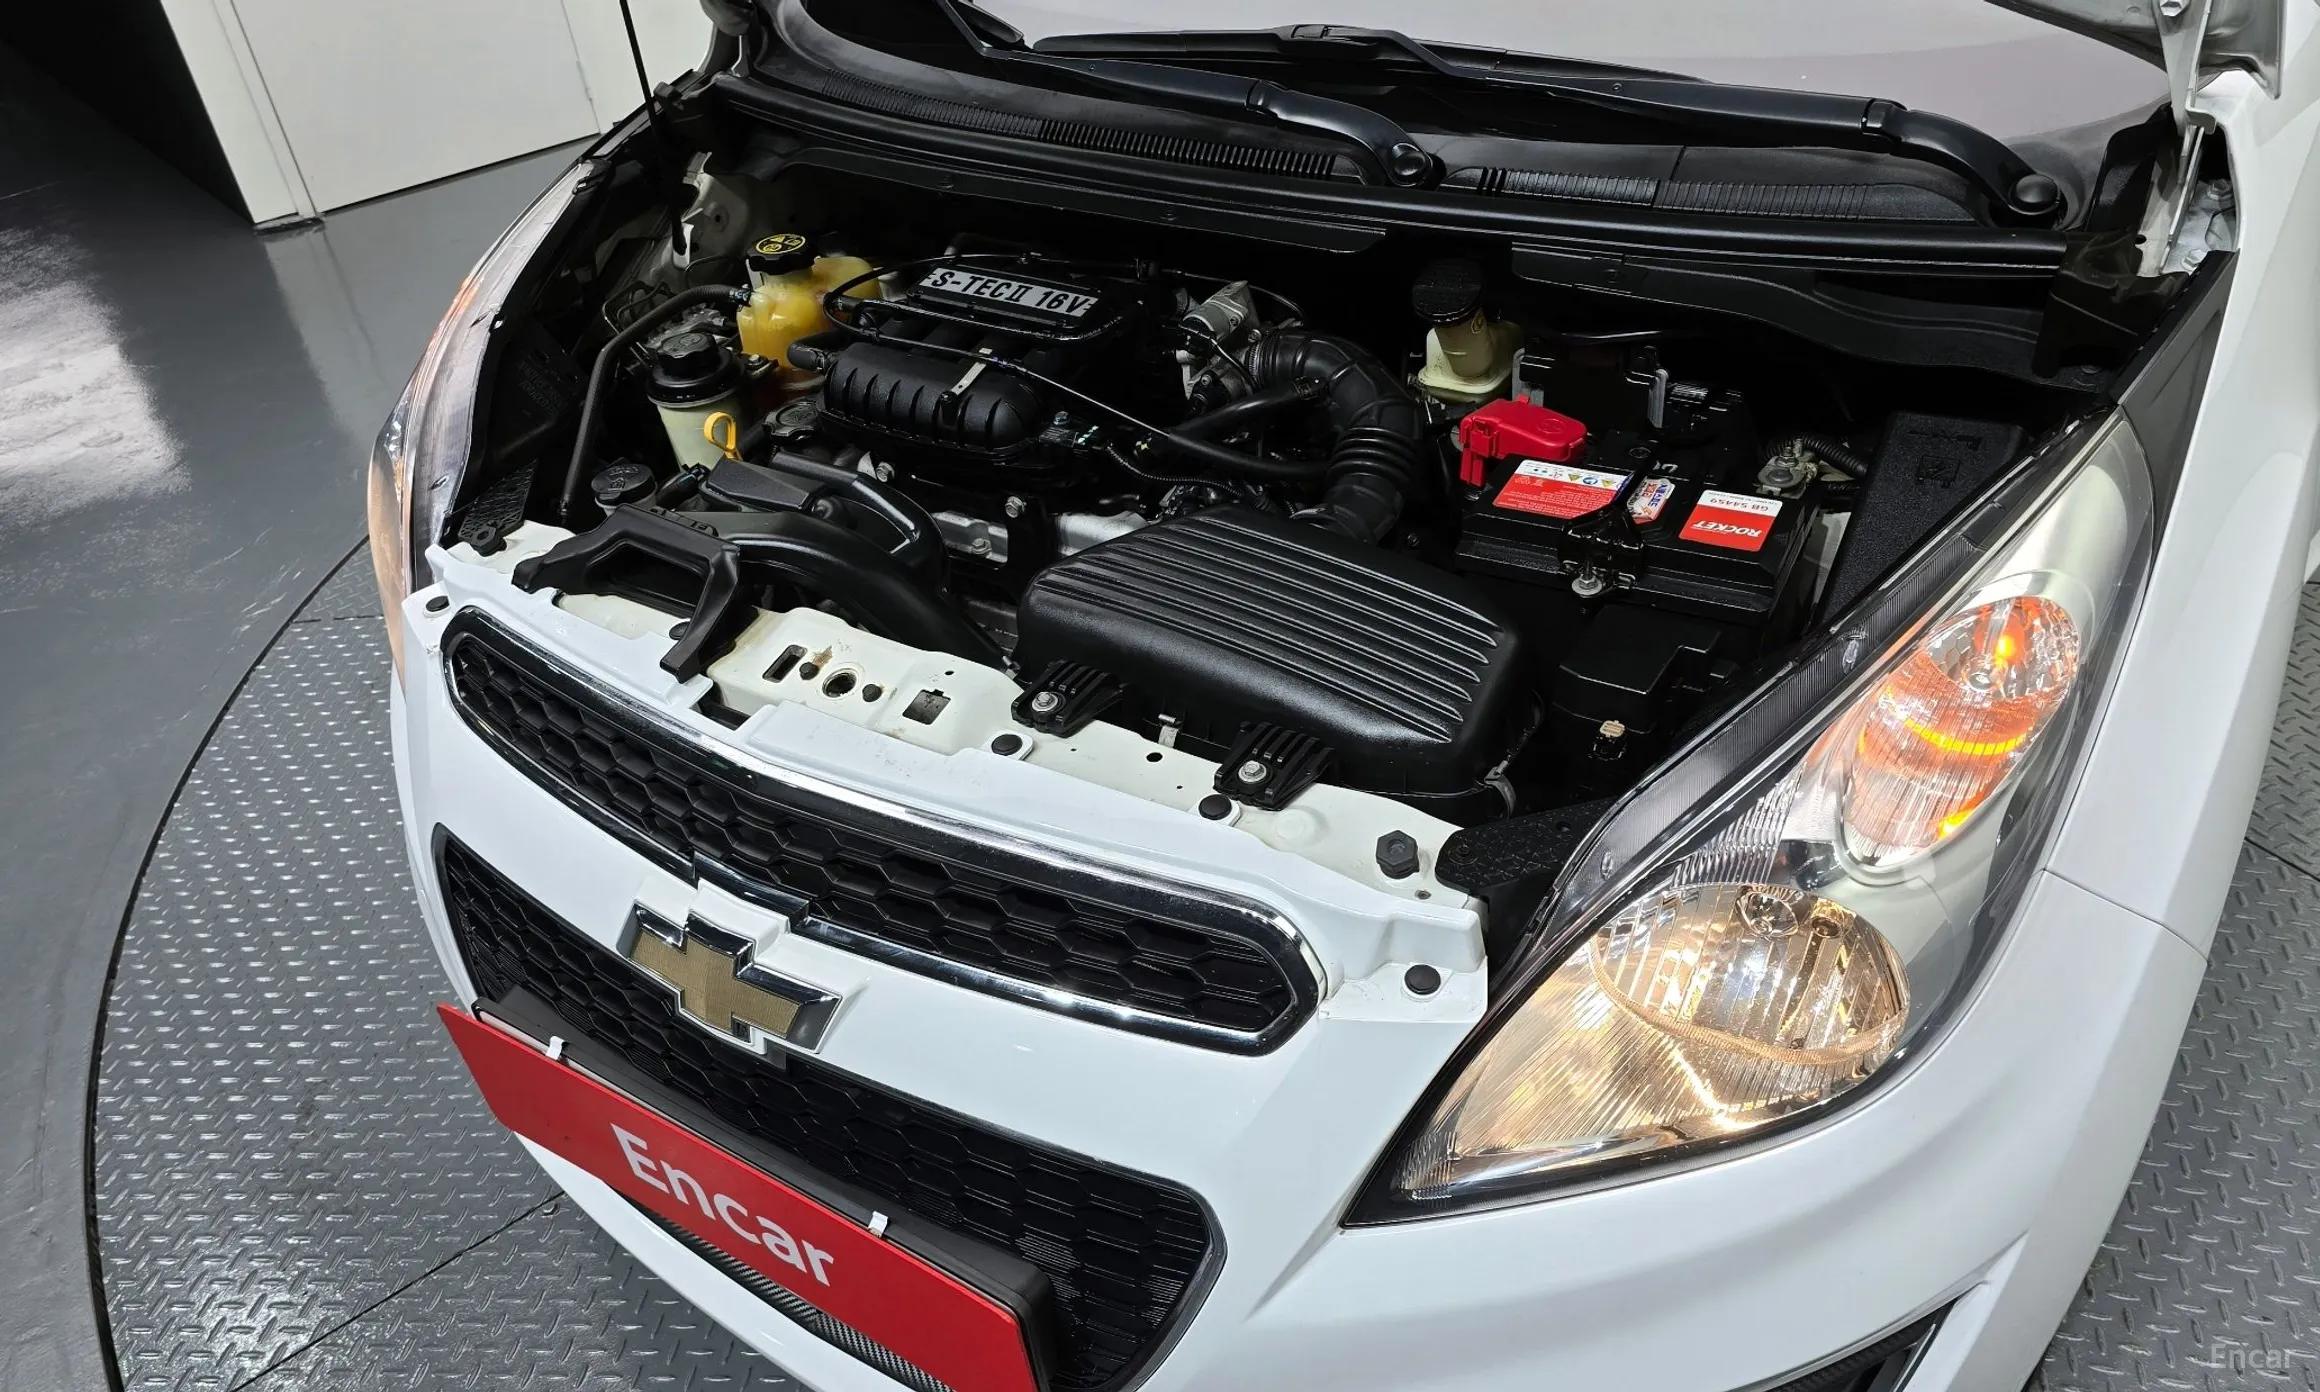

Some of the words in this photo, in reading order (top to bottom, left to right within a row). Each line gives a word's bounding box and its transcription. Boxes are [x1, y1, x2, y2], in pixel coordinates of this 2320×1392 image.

[1035, 290, 1091, 314] 16V
[1751, 503, 1769, 512] GB
[1692, 520, 1763, 538] ROCKET
[610, 1122, 834, 1286] Encar
